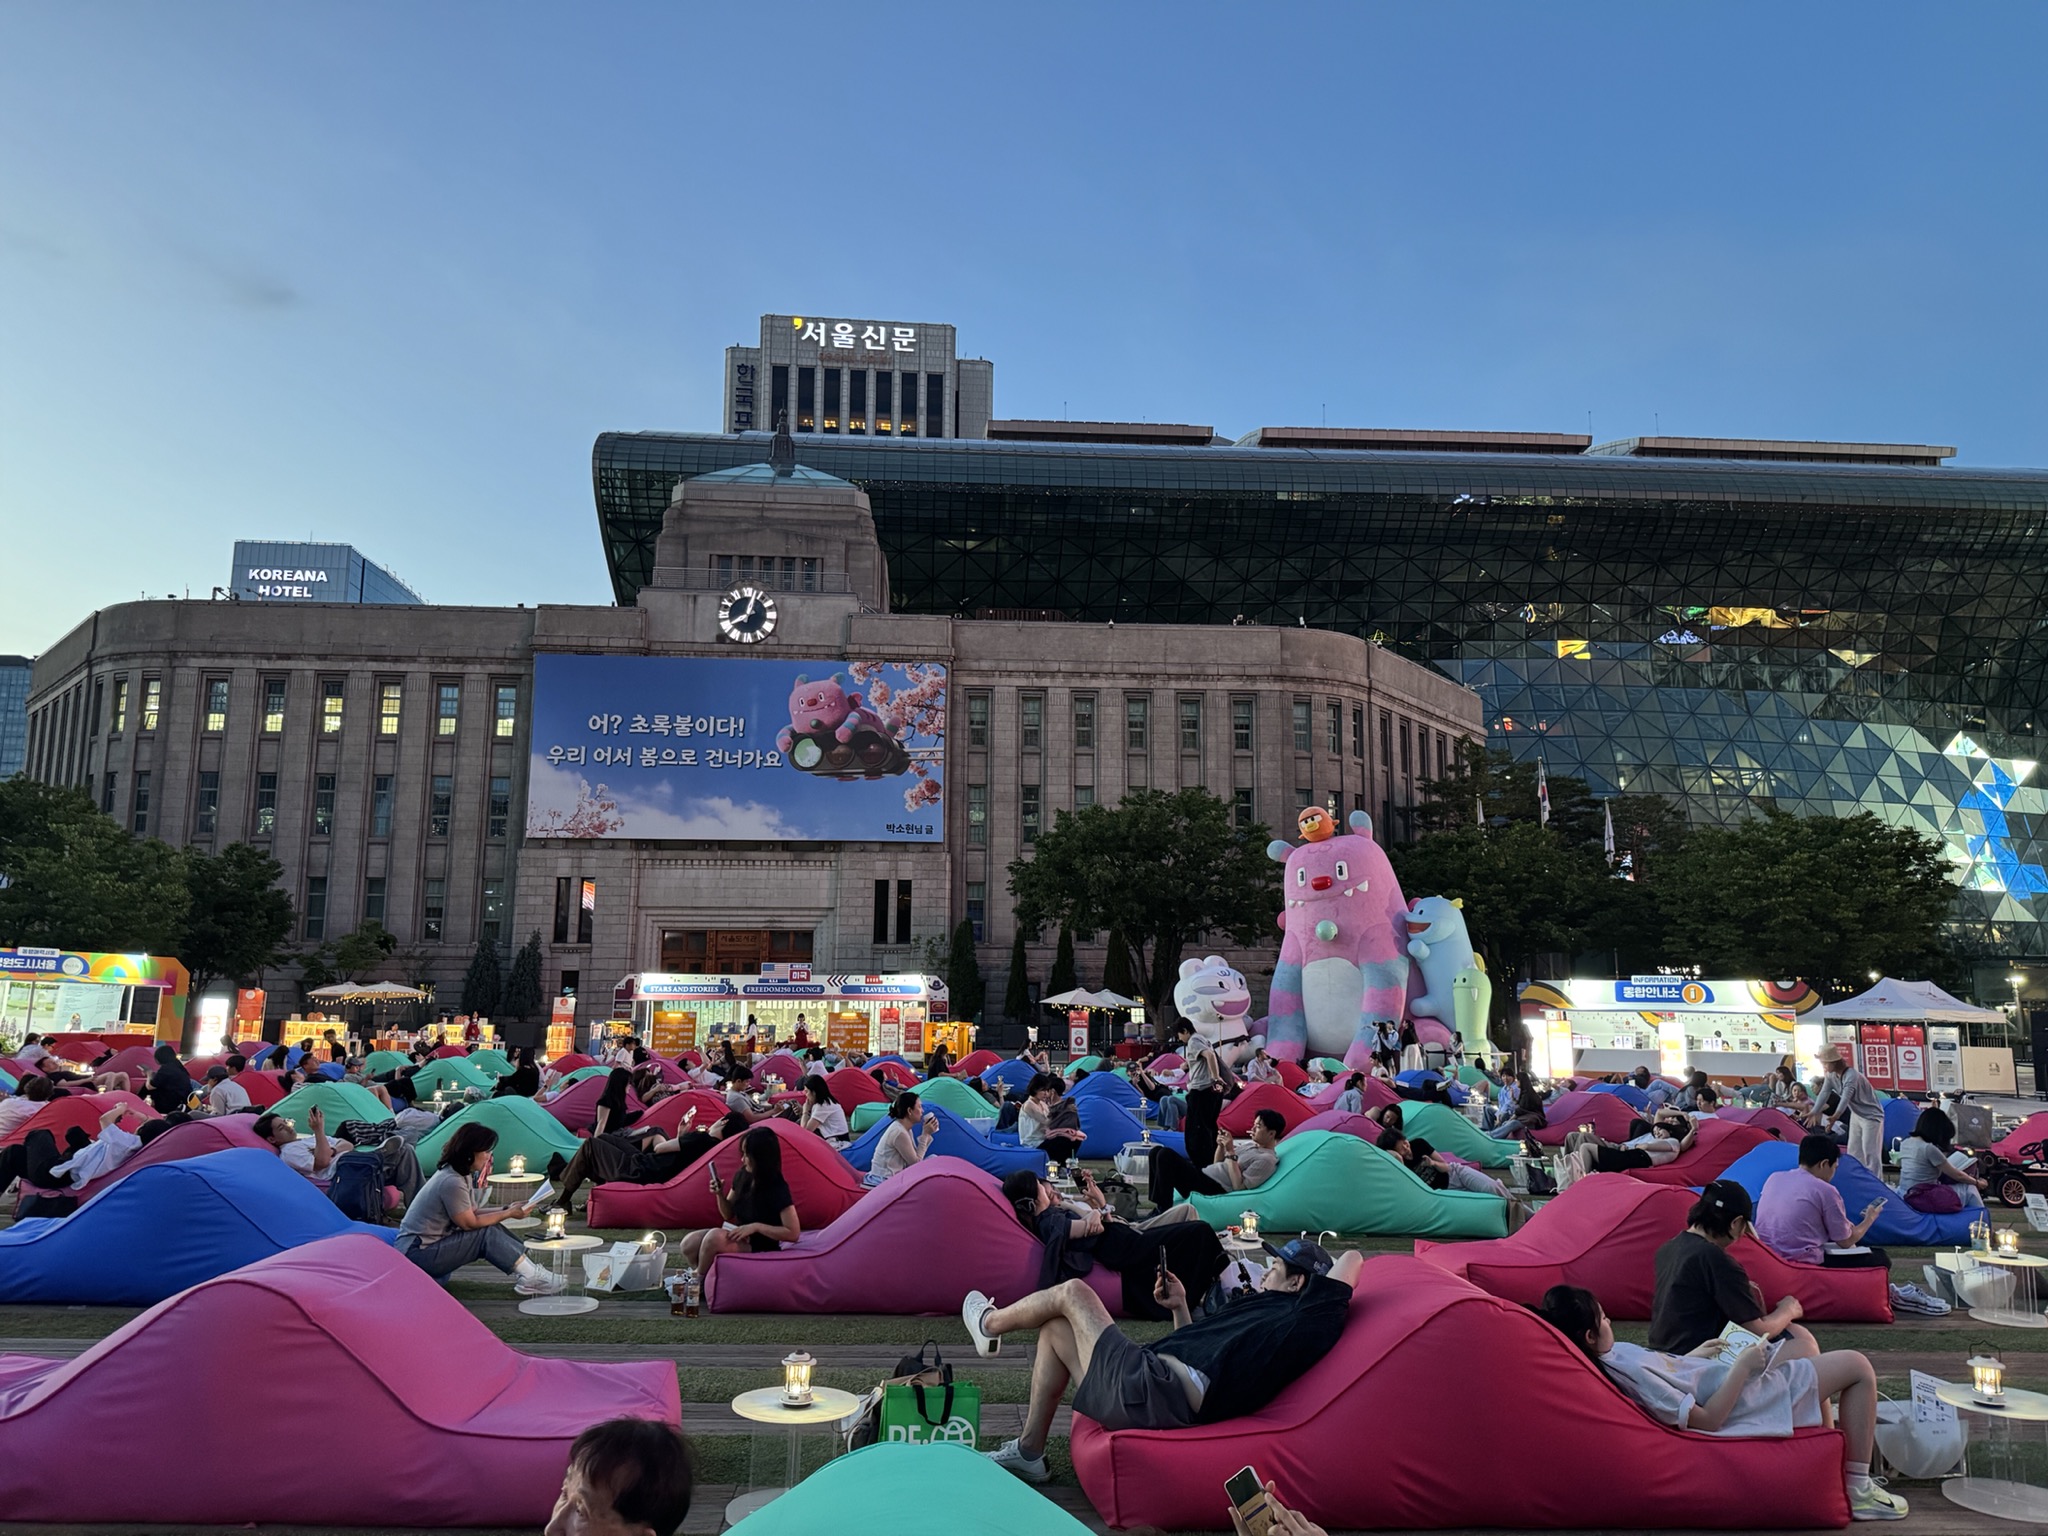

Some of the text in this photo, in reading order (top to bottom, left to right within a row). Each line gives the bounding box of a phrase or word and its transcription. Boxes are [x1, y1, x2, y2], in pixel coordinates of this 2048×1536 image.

[248, 568, 328, 582] KOREANA
[258, 584, 313, 598] HOTEL
[588, 713, 745, 737] 어? 초록불이다!
[546, 745, 783, 769] 우리 어서 봄으로 건너가요
[886, 823, 934, 835] 박소현님 글
[792, 971, 808, 979] 미국
[1633, 976, 1680, 984] INFORMATION
[650, 985, 672, 993] STARS
[1623, 986, 1680, 999] 통합안내소
